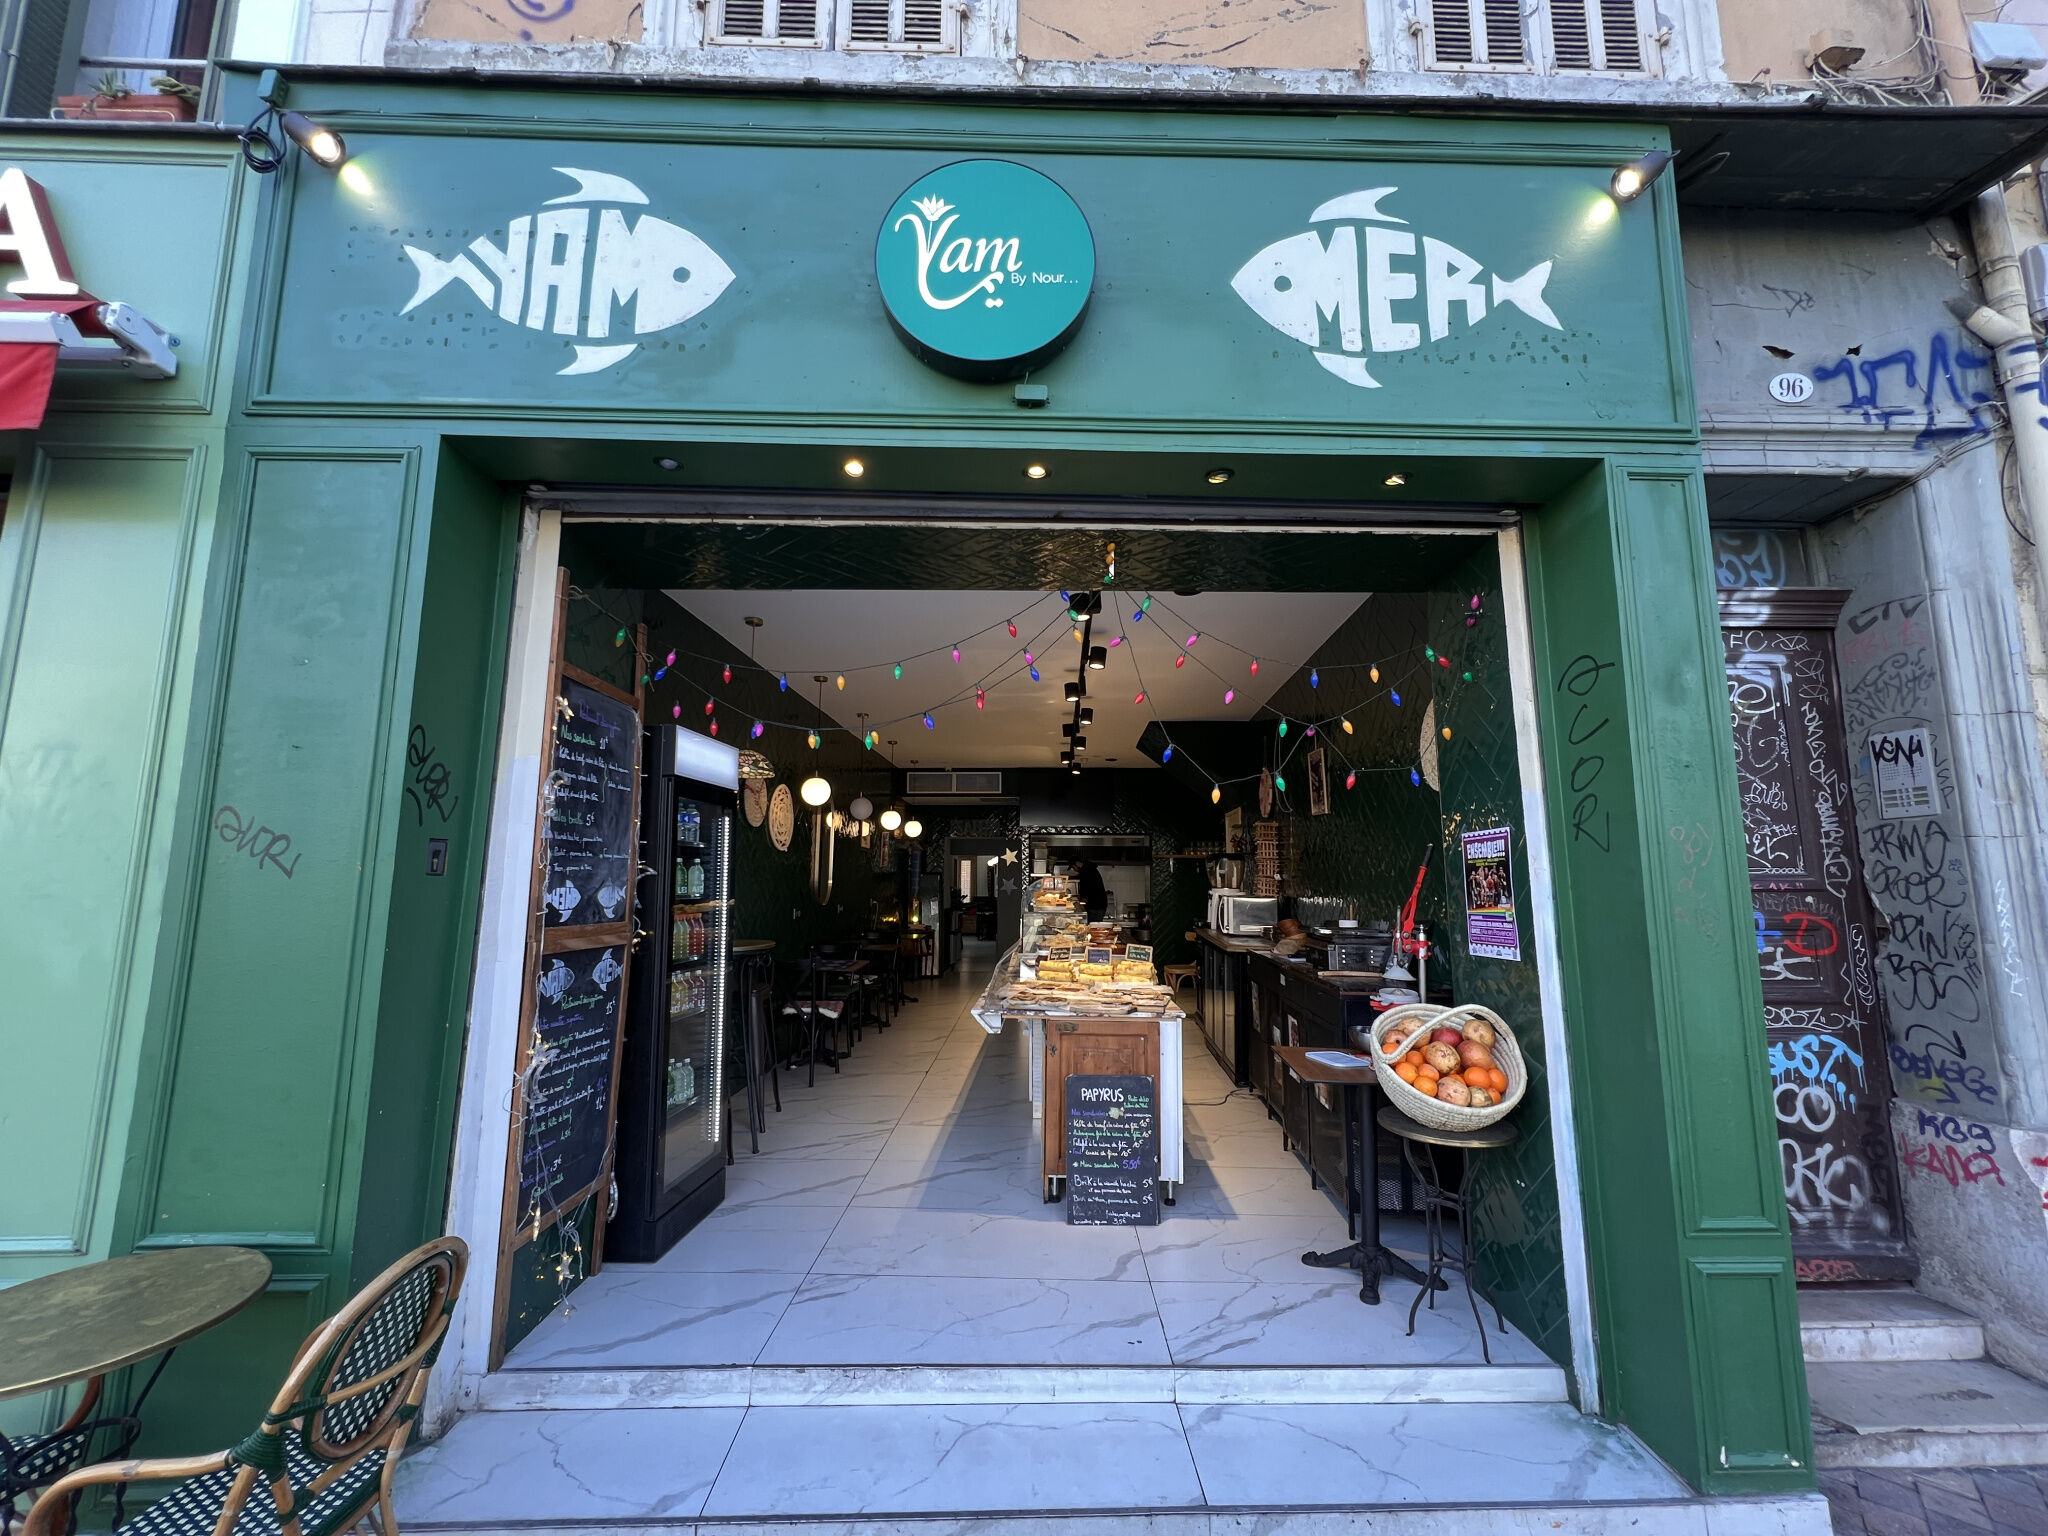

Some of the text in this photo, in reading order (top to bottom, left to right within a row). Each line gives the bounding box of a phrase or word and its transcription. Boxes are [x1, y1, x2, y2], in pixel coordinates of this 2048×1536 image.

[468, 208, 737, 338] YAM
[895, 213, 1022, 310] Yam
[1011, 273, 1027, 287] By
[1230, 226, 1487, 352] MER
[1778, 376, 1804, 397] 96
[1081, 1087, 1125, 1102] PAPYRUS
